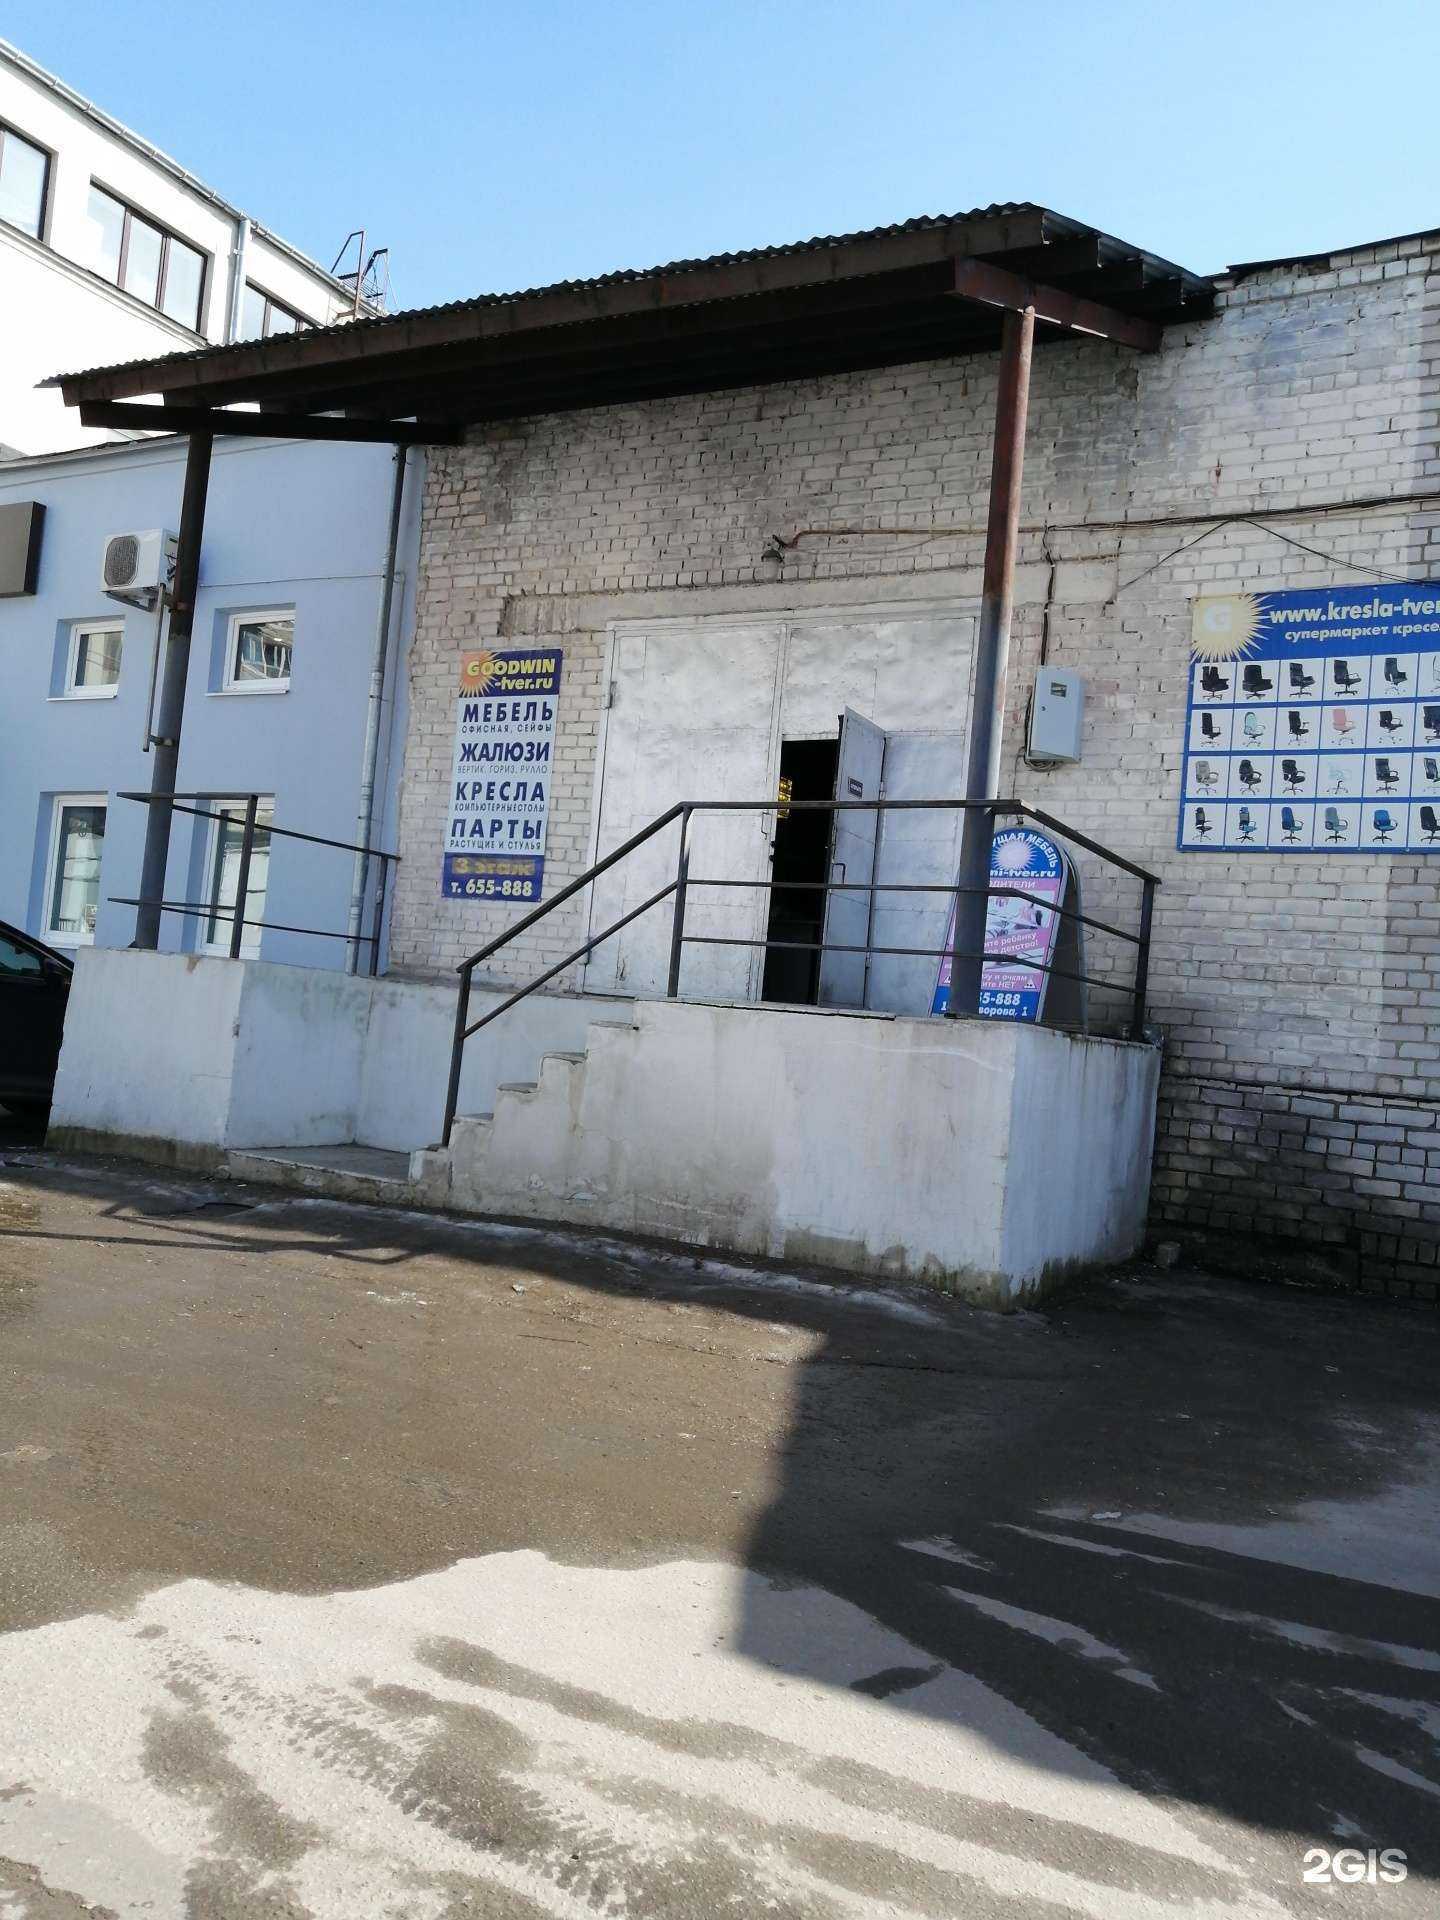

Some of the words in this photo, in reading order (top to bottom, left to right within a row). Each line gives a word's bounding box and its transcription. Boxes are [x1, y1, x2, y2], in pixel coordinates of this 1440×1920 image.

[1285, 626, 1388, 642] супермаркет
[1393, 622, 1440, 637] кресе
[467, 659, 555, 676] GOODWIN
[463, 701, 553, 722] МЕБЕЛЬ
[461, 724, 513, 734] ОФИСНАЯ,
[517, 722, 552, 732] СЕЙФЫ
[459, 742, 550, 762] ЖАЛЮЗИ
[520, 764, 548, 774] РУЛЛО
[455, 781, 545, 802] КРЕСЛА
[451, 819, 542, 839] ПАРТЫ
[449, 839, 495, 850] РАСТУЩИЕ
[507, 841, 541, 850] СТУЛЬЯ
[1025, 833, 1059, 868] МЕБЕЛЬ
[465, 879, 533, 897] 655-888
[1021, 1006, 1028, 1017] 1
